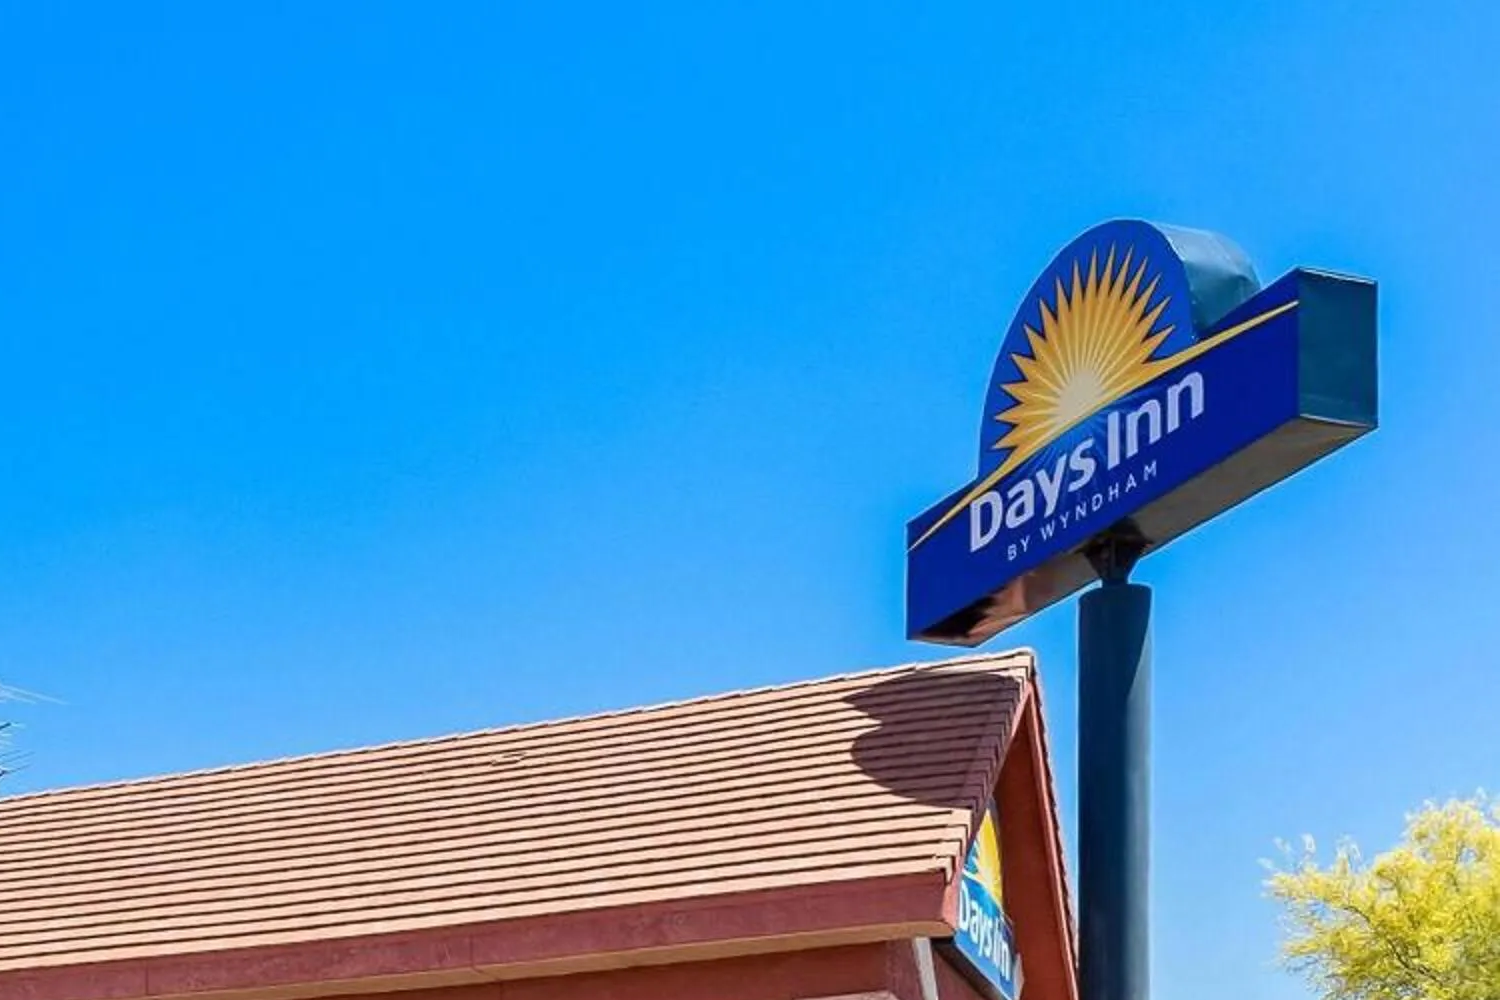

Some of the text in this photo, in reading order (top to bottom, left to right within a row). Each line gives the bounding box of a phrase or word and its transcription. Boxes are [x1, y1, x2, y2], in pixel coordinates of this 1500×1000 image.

[970, 371, 1204, 552] Days Inn
[1007, 460, 1157, 561] BY WYNDHAM
[959, 880, 993, 957] Days
